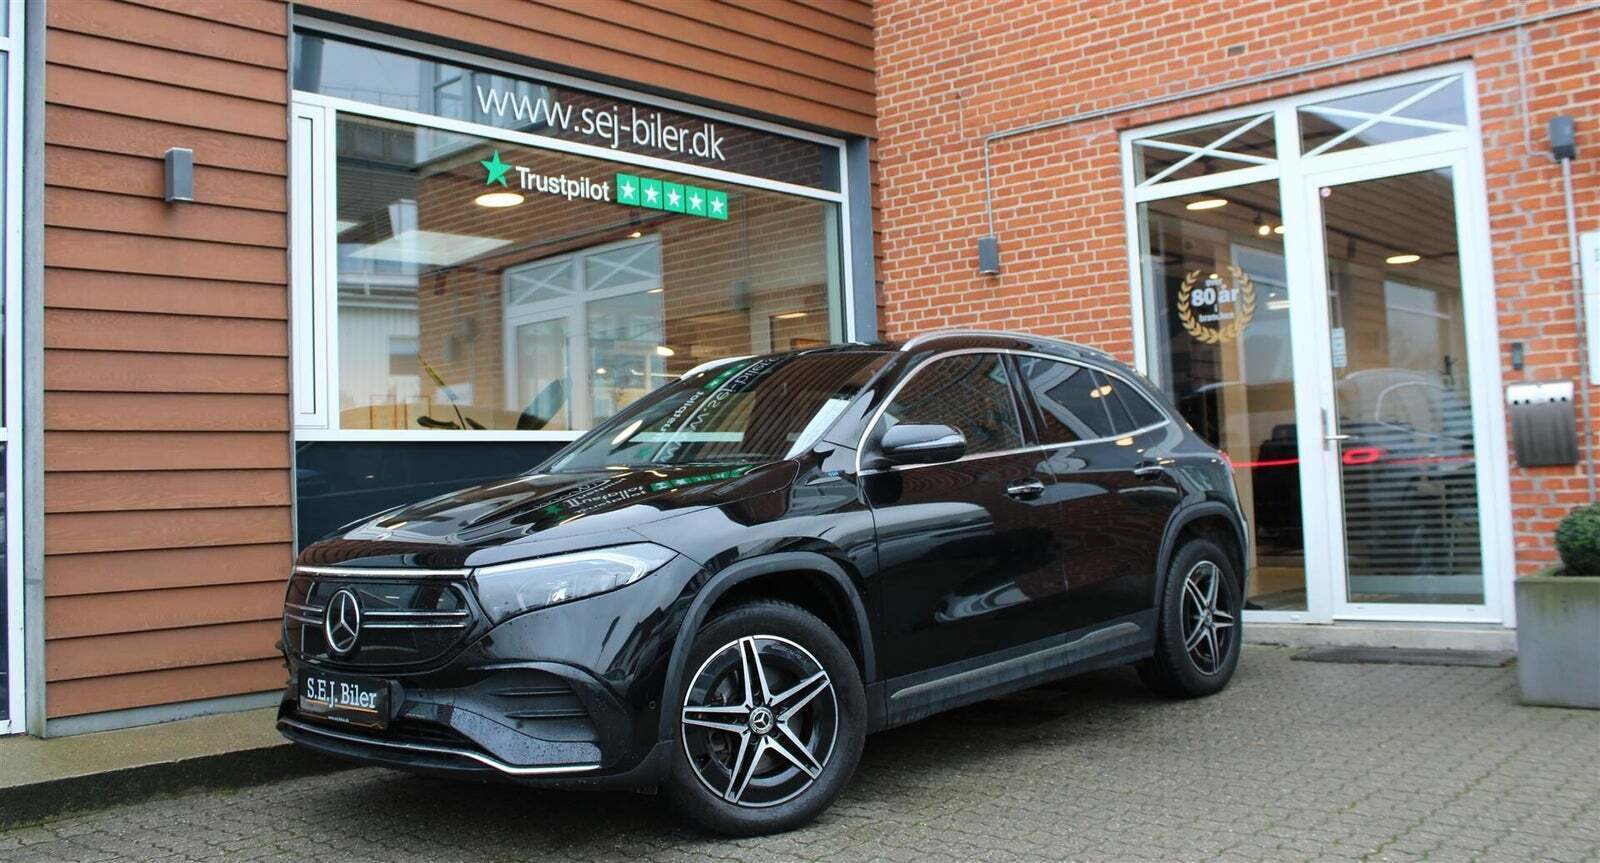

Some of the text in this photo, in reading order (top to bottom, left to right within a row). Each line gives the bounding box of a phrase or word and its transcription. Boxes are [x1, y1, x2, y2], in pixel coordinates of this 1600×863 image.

[476, 85, 726, 161] www.sej-biler.dk
[515, 166, 610, 202] Trustpilot
[1190, 287, 1216, 307] 80
[306, 677, 377, 708] S.E.J. Biler
